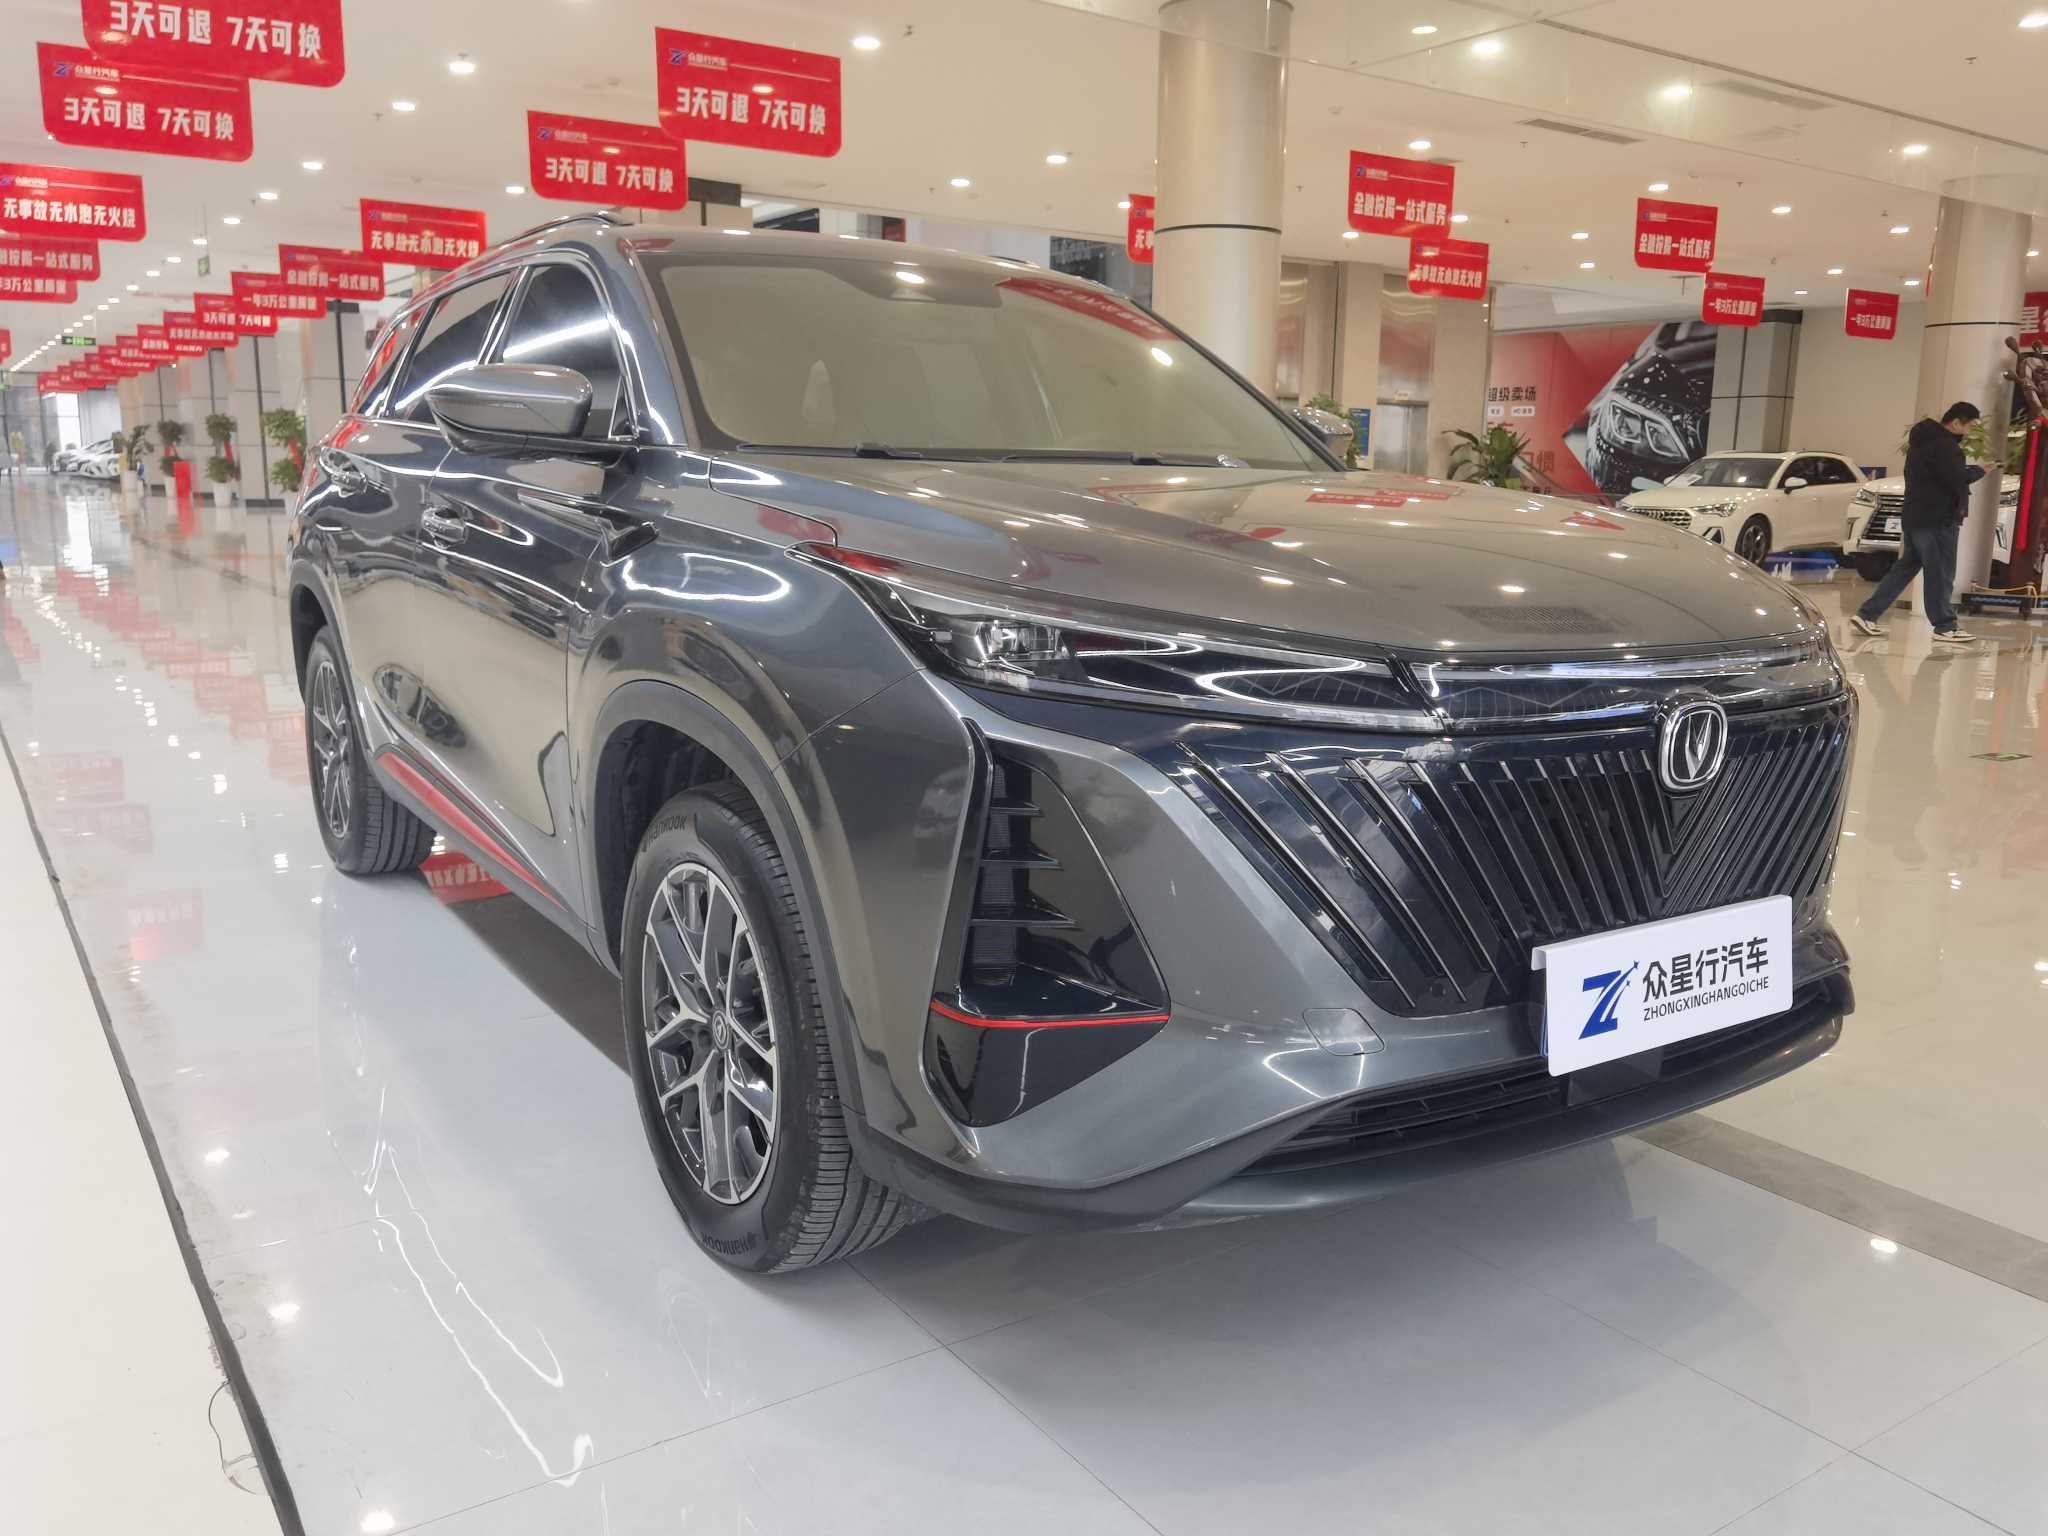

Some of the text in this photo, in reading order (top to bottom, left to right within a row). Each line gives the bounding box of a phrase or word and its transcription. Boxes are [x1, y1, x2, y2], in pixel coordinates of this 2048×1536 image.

[109, 1, 321, 60] 3天可退 7天可换
[64, 97, 234, 140] 3天可退 7天可换
[676, 87, 826, 135] 3天可退 7天可换
[545, 157, 673, 192] 3天可退 7天可换
[3, 197, 136, 228] 无事故无水泡无火烧
[1642, 936, 1769, 1003] 众星行汽车
